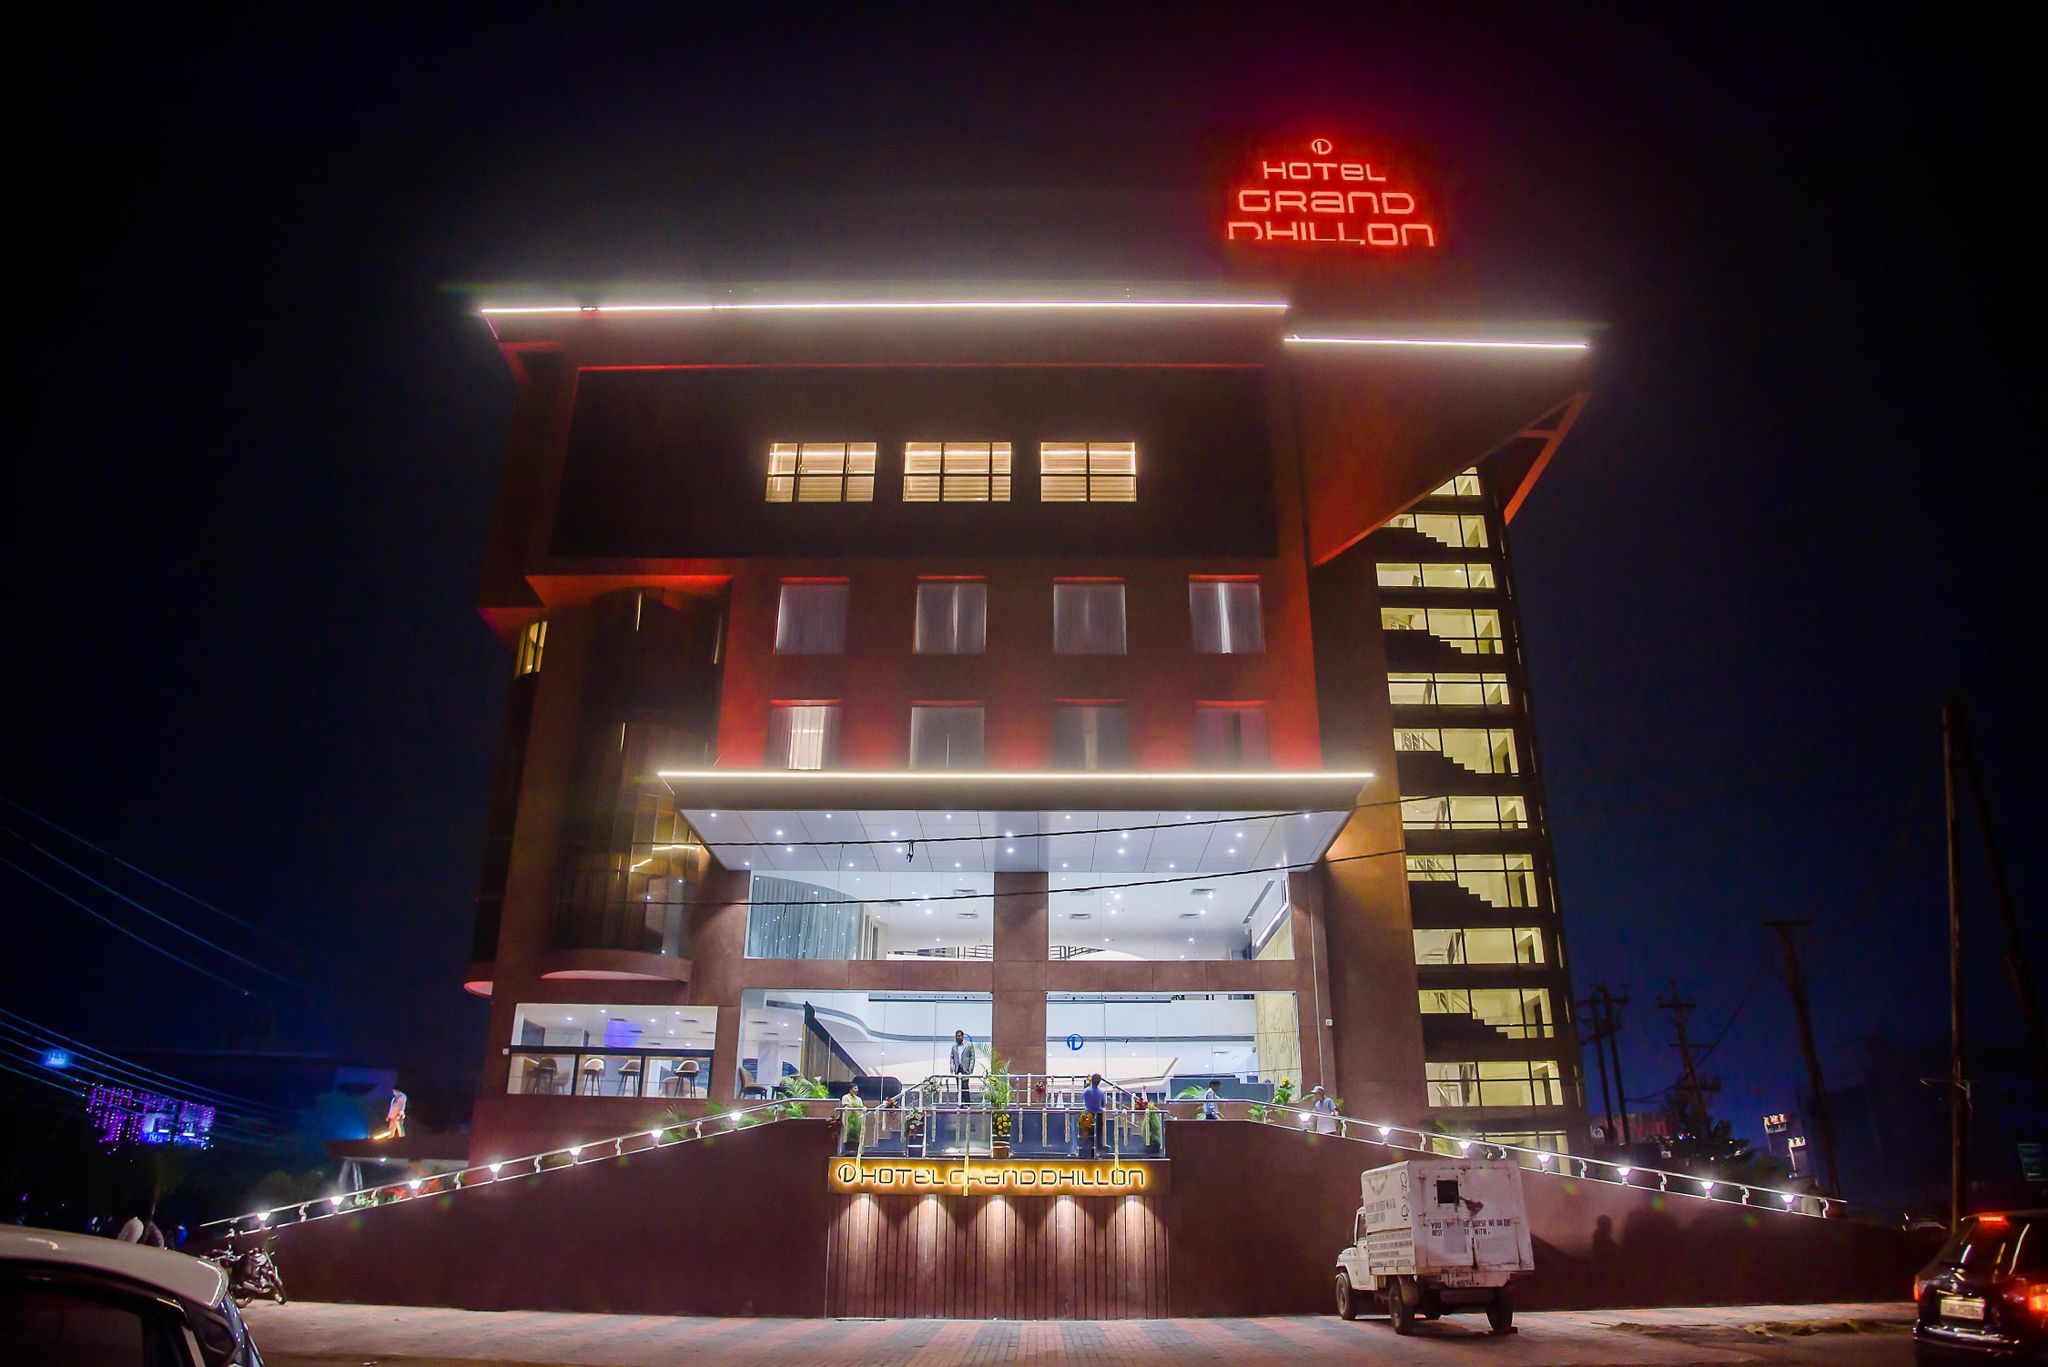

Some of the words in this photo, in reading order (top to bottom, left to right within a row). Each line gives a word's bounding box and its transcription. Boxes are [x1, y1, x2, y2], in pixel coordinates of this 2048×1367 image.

[1262, 161, 1386, 182] HOTEL
[1238, 189, 1415, 215] GRAND
[860, 1168, 945, 1185] HOTEL
[1041, 1169, 1144, 1186] DHILLON
